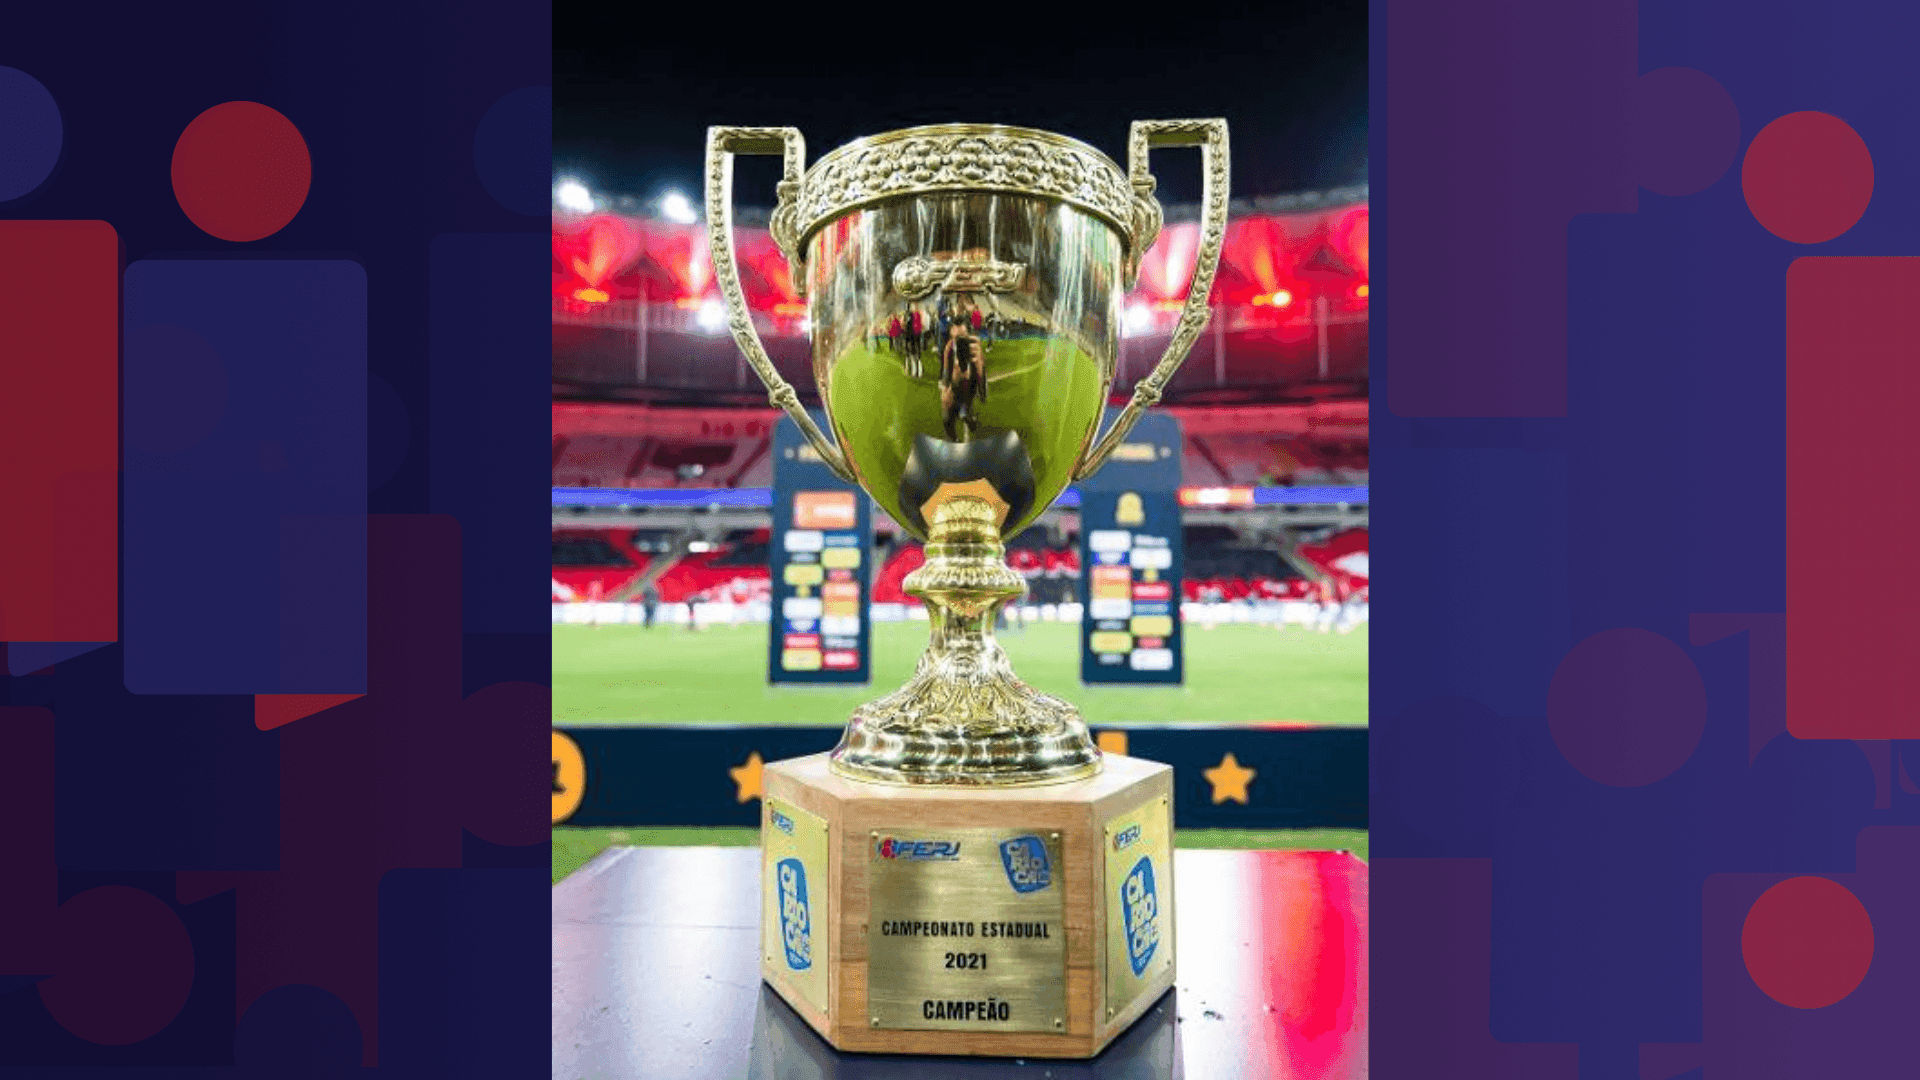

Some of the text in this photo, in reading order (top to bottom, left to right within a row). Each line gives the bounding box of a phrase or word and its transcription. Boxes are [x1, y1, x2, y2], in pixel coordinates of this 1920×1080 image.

[896, 841, 961, 856] FERJ
[881, 920, 1050, 939] CAMPEONATO ESTADUAL
[945, 952, 987, 970] 2021
[923, 997, 1010, 1021] CAMPEÃO
